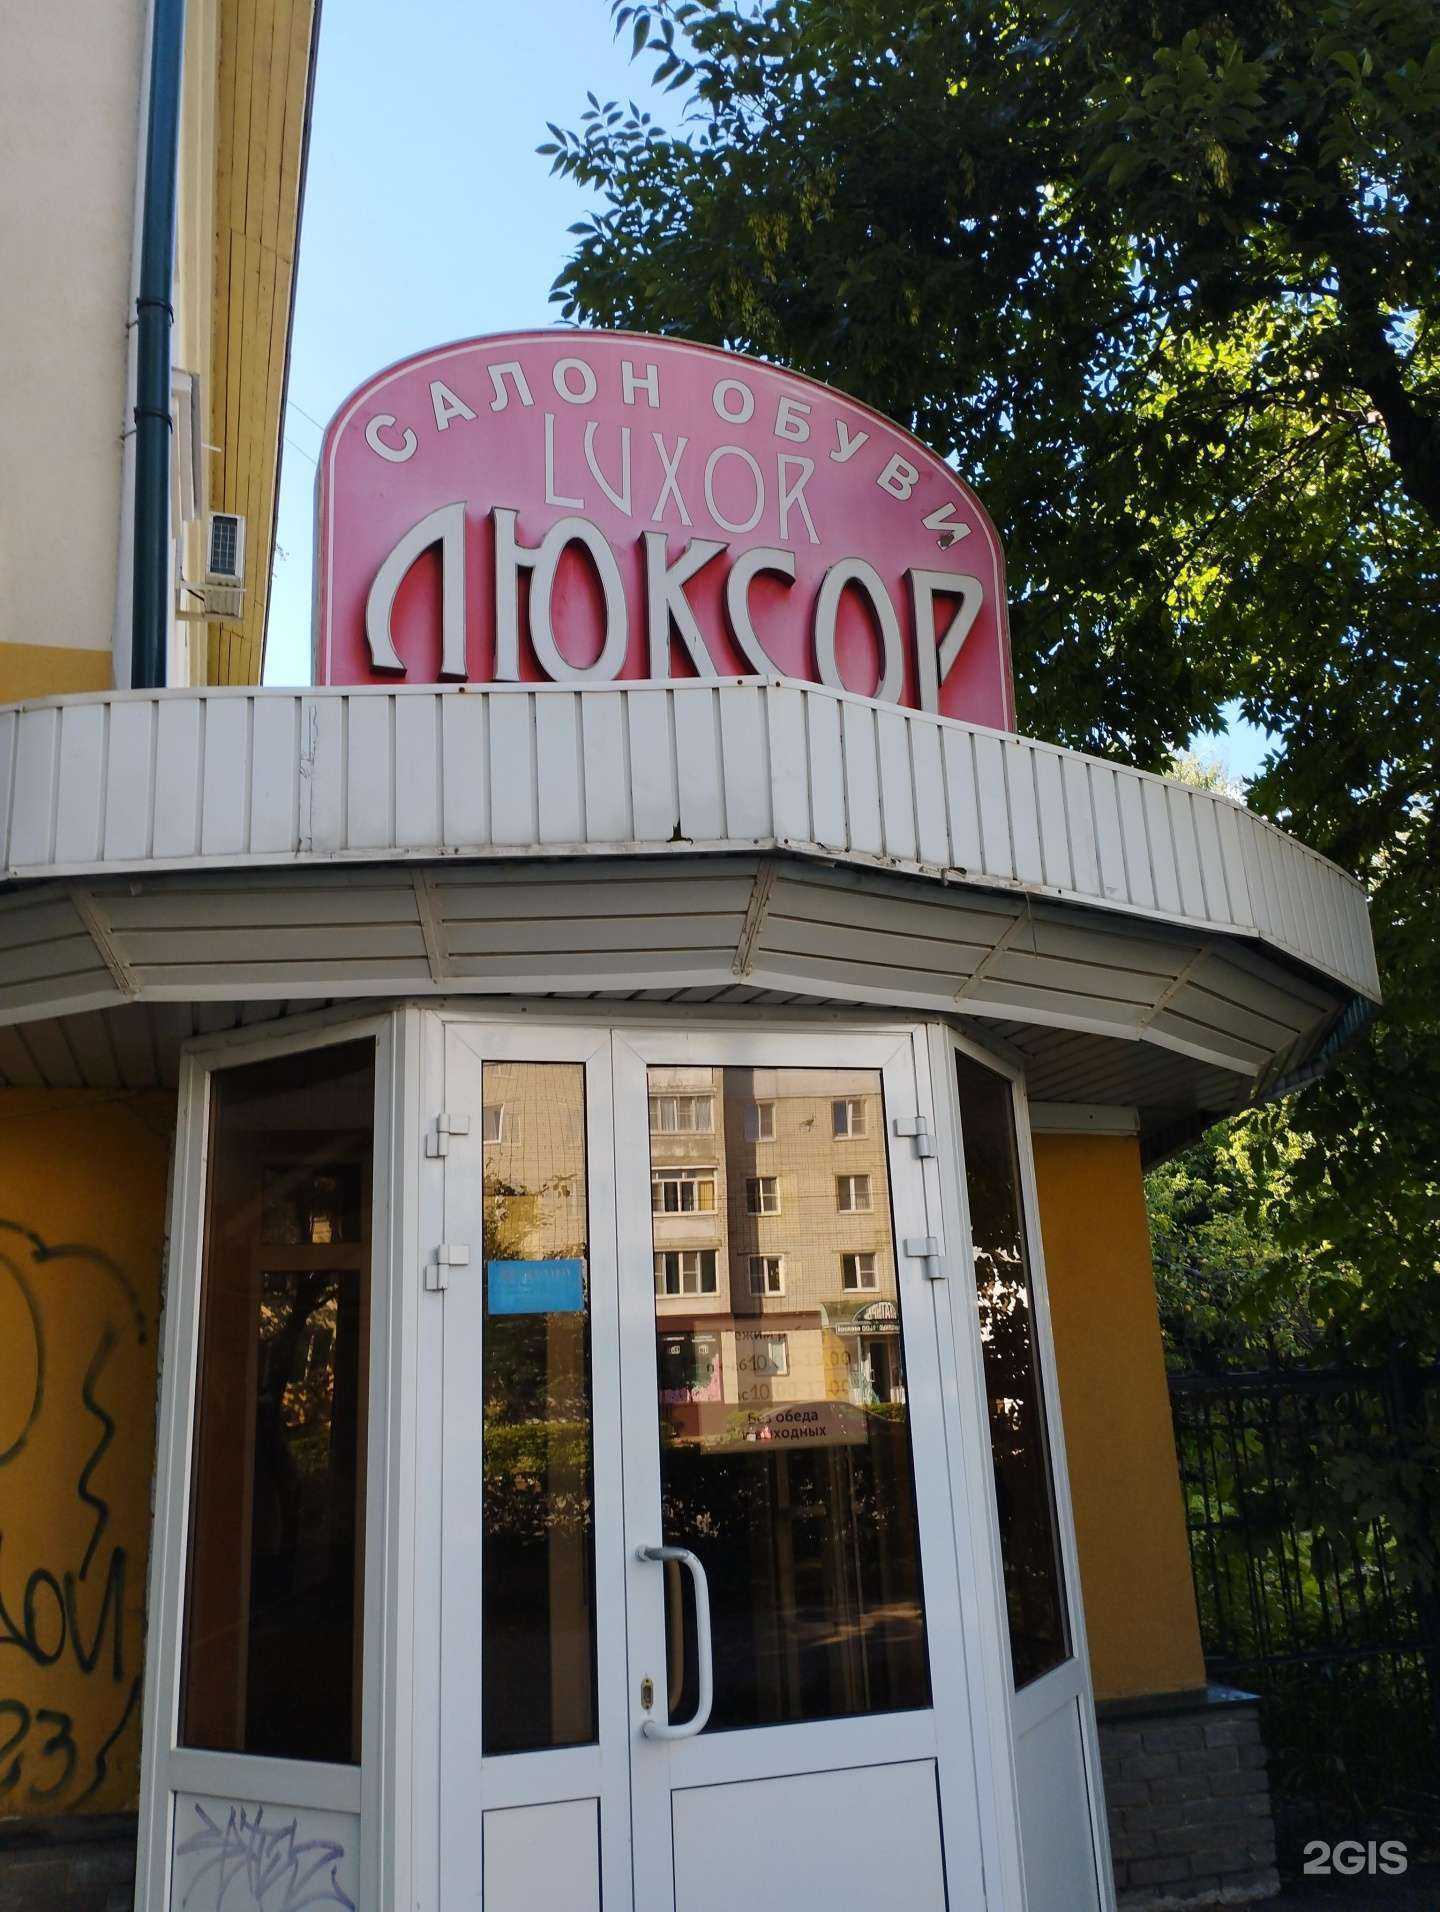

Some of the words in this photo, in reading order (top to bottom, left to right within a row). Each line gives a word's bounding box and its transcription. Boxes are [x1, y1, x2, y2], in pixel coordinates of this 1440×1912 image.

[364, 357, 661, 463] САЛОН
[711, 378, 972, 551] ОБУВИ
[544, 412, 822, 545] LUXOR
[365, 501, 984, 712] ЛЮКСОР
[775, 1409, 818, 1423] обеда
